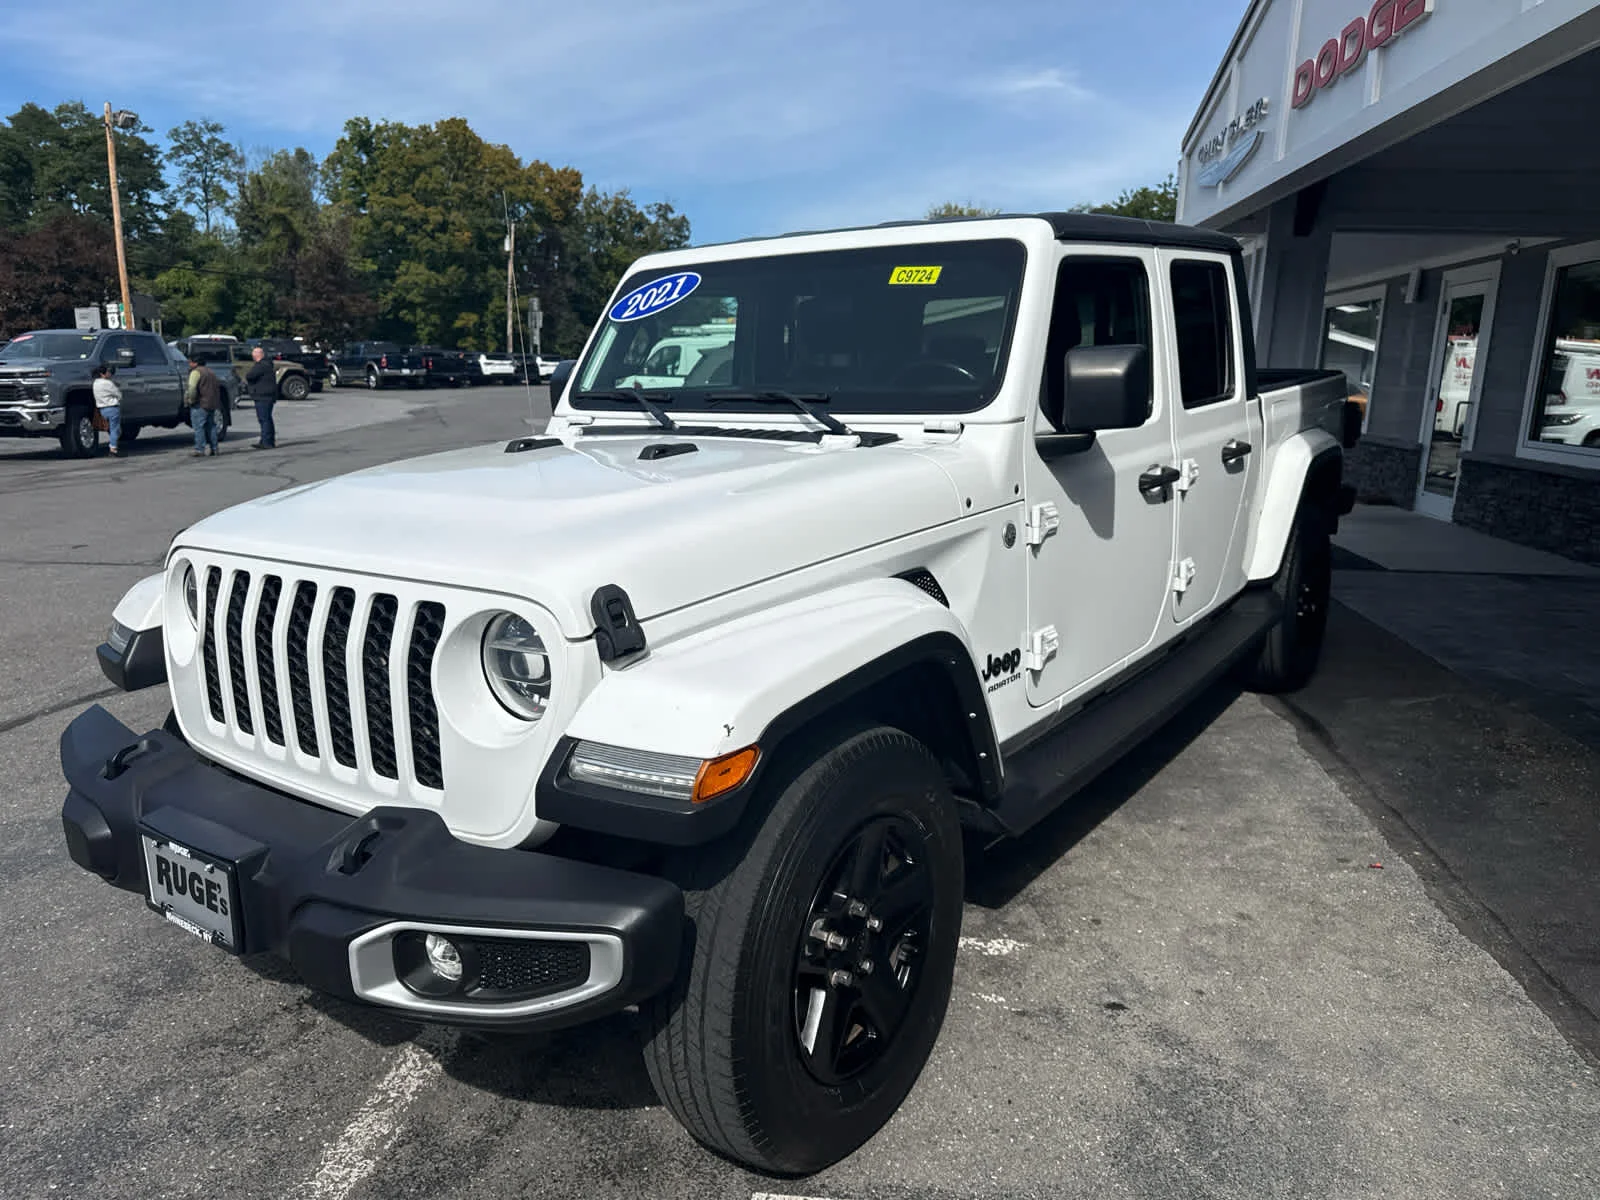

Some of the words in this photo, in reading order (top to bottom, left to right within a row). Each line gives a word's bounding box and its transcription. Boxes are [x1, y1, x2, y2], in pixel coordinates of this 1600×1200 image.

[896, 269, 934, 282] C9724
[621, 275, 687, 318] 2021
[981, 647, 1021, 682] Jeep
